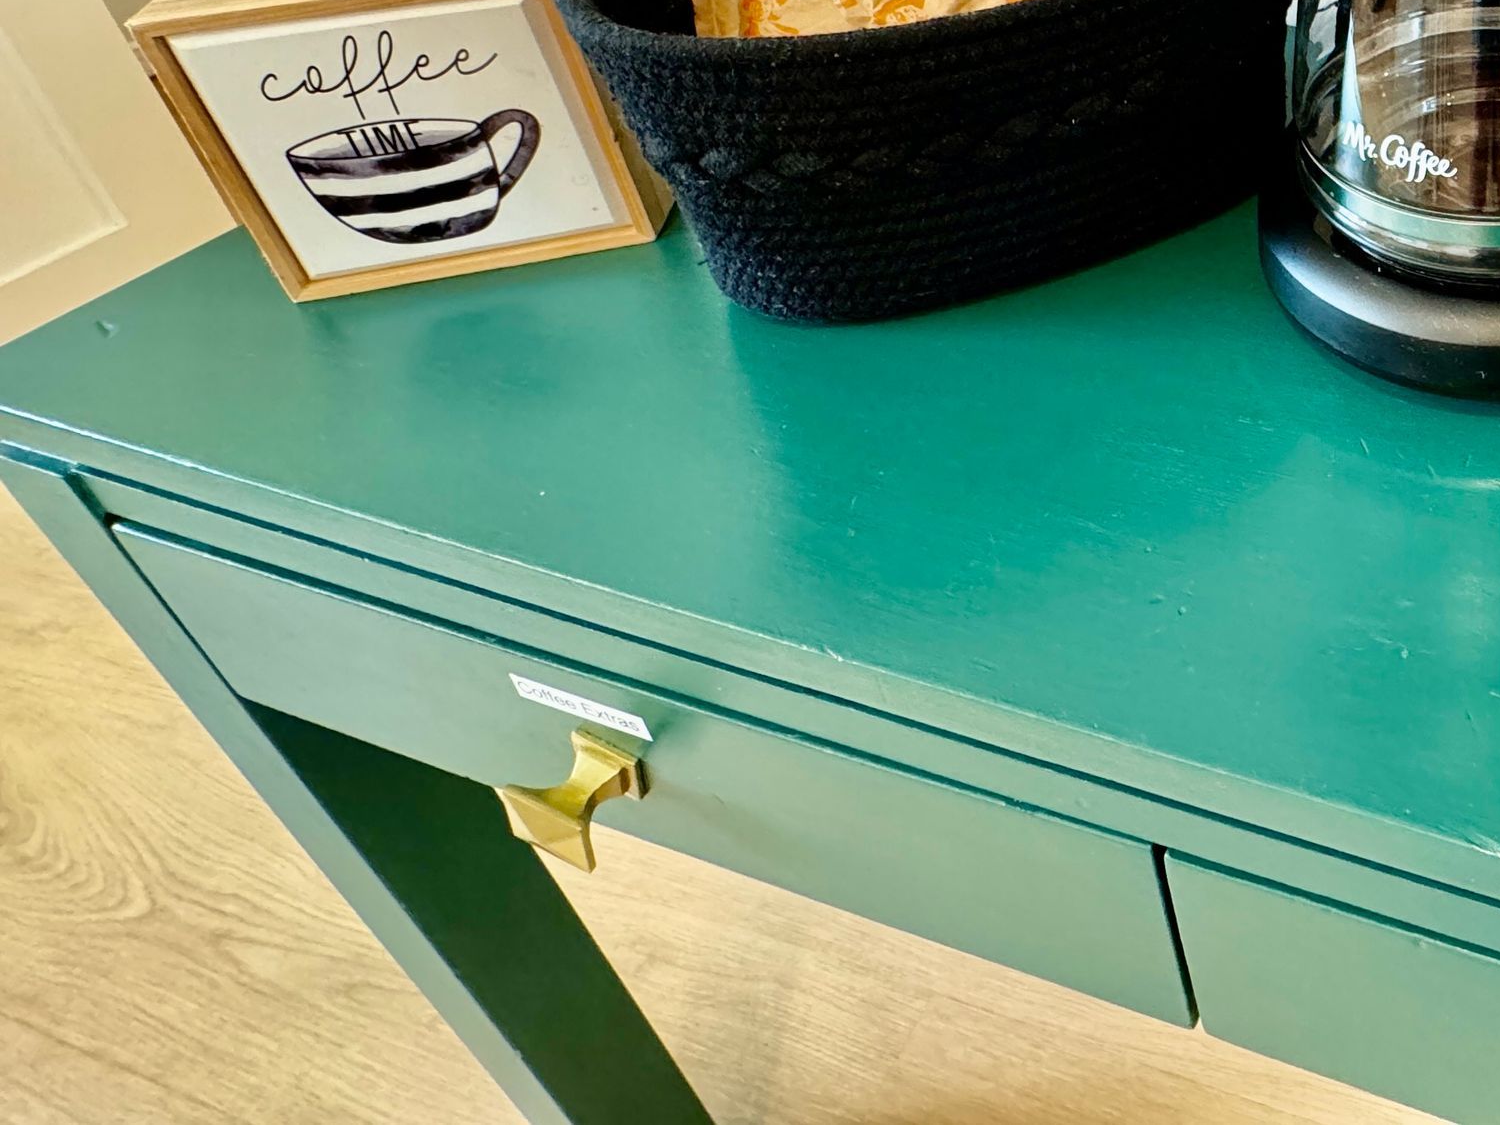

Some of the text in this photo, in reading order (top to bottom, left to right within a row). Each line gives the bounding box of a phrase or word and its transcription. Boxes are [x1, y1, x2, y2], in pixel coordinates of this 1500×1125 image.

[260, 30, 498, 120] coffee
[336, 120, 423, 158] TIME
[1342, 120, 1458, 183] Mr. Coffee
[516, 680, 641, 733] Coffee Extras
